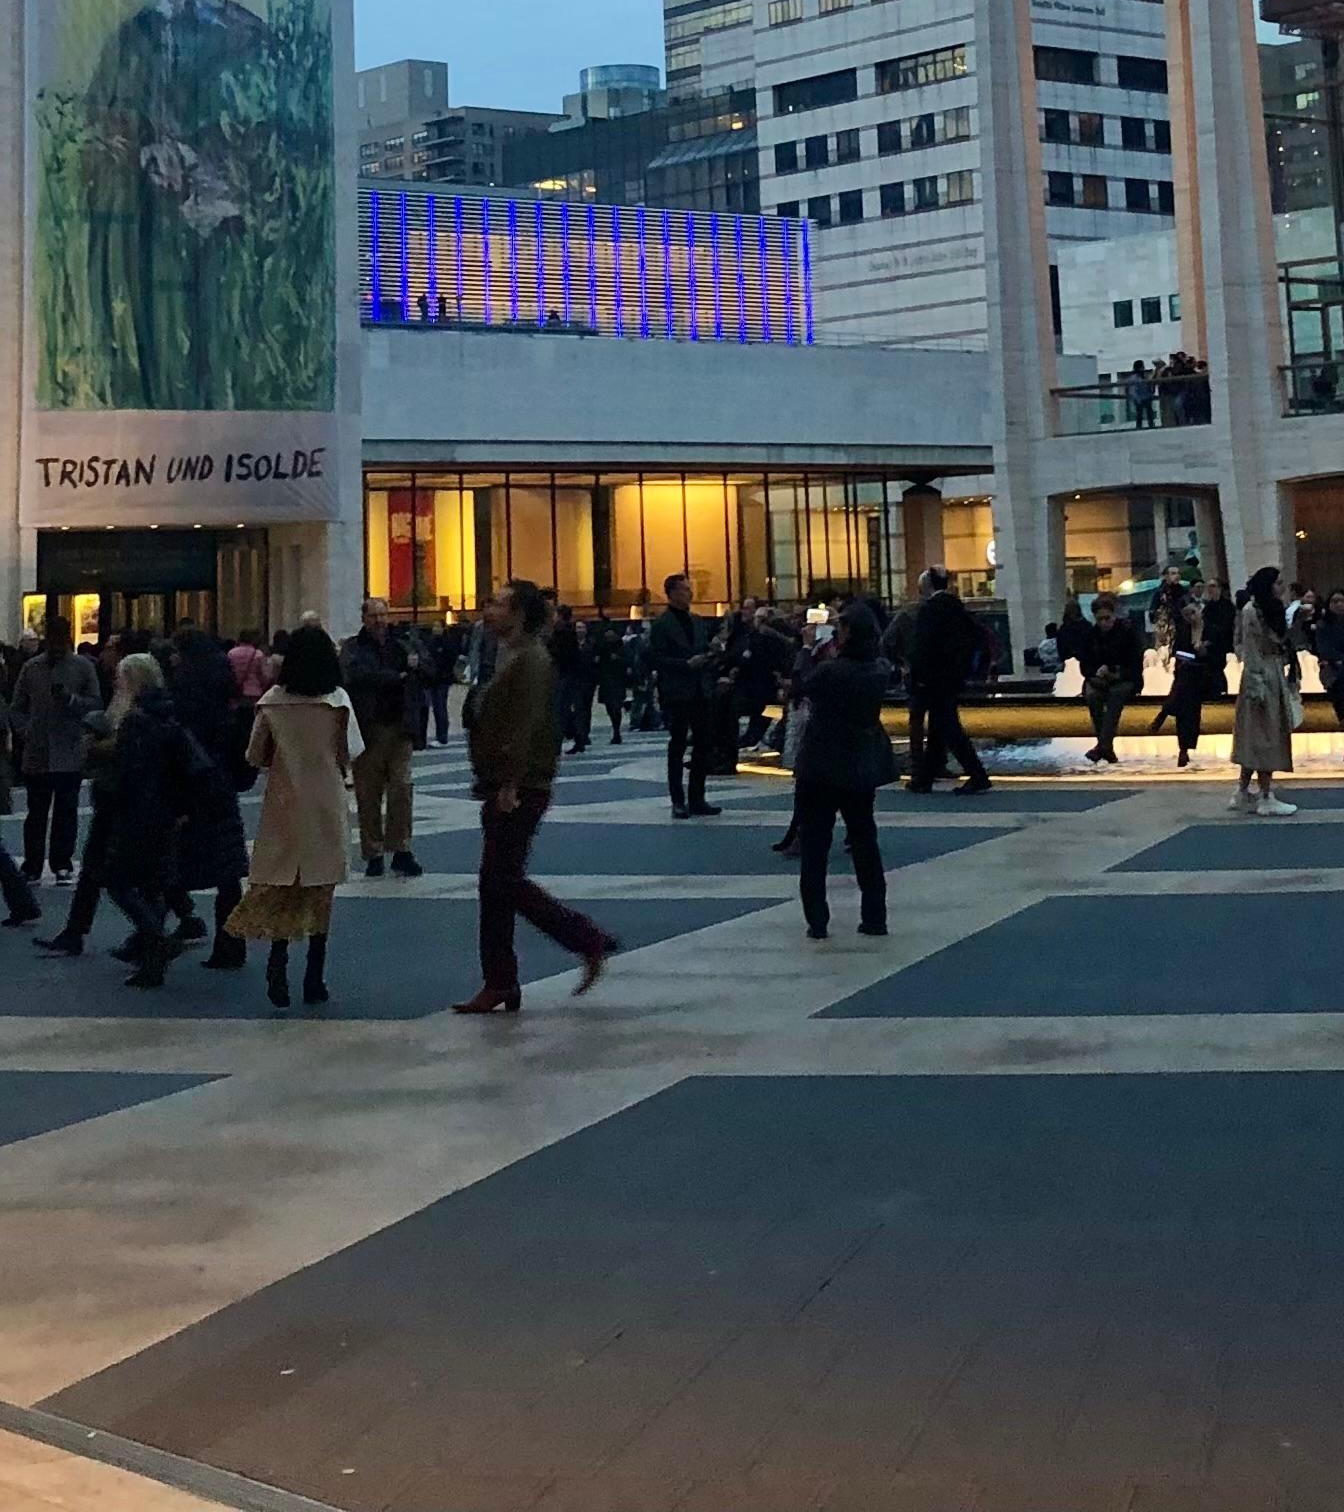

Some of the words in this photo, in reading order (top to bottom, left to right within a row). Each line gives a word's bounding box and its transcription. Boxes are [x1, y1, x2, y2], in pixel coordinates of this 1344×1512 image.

[35, 454, 156, 489] TRISTAN
[167, 454, 214, 484] UND
[224, 447, 326, 483] ISOLDE
